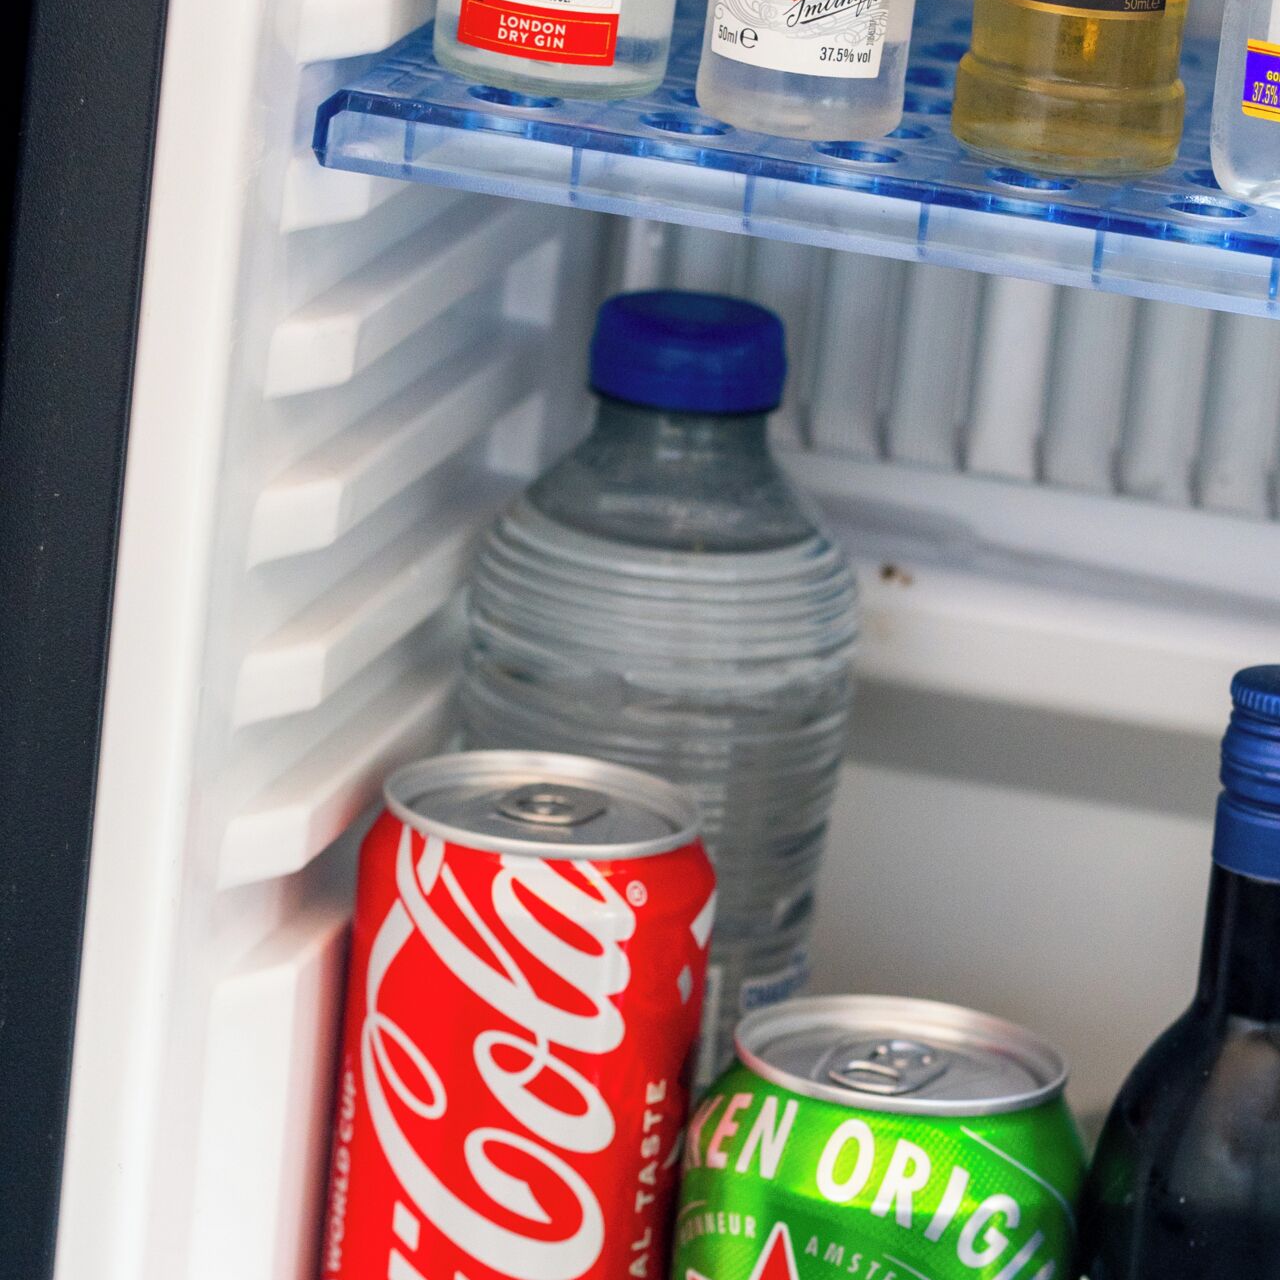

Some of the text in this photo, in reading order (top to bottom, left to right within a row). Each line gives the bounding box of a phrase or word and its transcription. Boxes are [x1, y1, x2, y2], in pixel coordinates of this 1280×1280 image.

[500, 14, 566, 36] LONDON
[718, 24, 738, 45] 50ml
[498, 28, 565, 49] DRY GIN
[820, 46, 871, 63] 37.5% vol
[1252, 81, 1279, 106] 37.5%
[636, 1079, 667, 1212] TASTE
